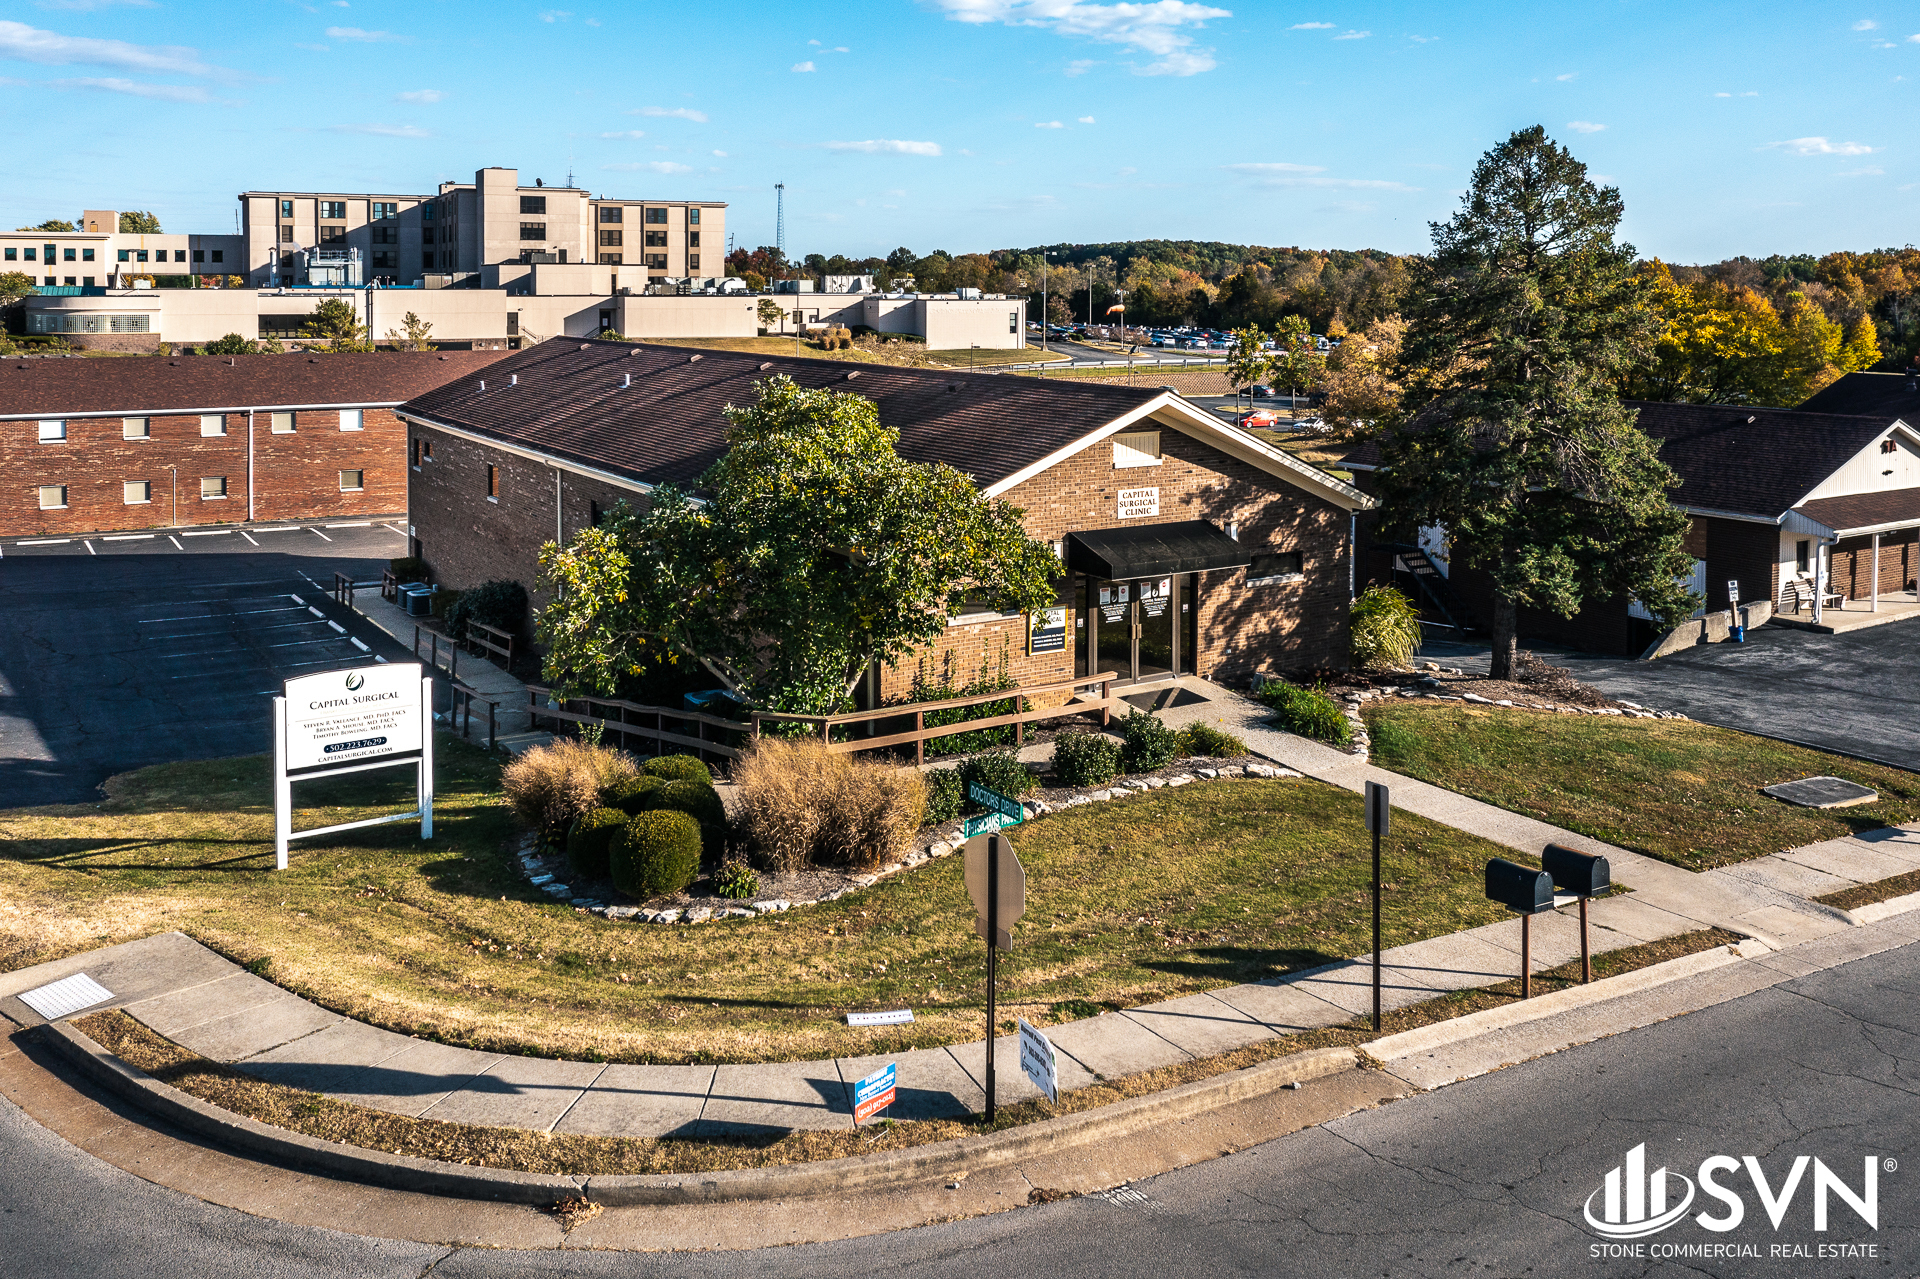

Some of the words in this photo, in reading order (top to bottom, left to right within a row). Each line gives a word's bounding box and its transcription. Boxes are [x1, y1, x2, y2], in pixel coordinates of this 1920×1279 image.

[1122, 490, 1154, 499] CAPITAL
[1119, 498, 1157, 508] SURGICAL
[1125, 507, 1151, 516] CLINIC
[310, 698, 349, 710] CAPITAL
[353, 692, 399, 704] SURGICAL
[318, 747, 393, 762] CAPITALSURGICAL.COM
[970, 785, 999, 809] DOCTORS
[1001, 798, 1019, 818] DRIVE
[967, 813, 1000, 836] PHYSICIANS
[858, 1103, 872, 1118] (502)
